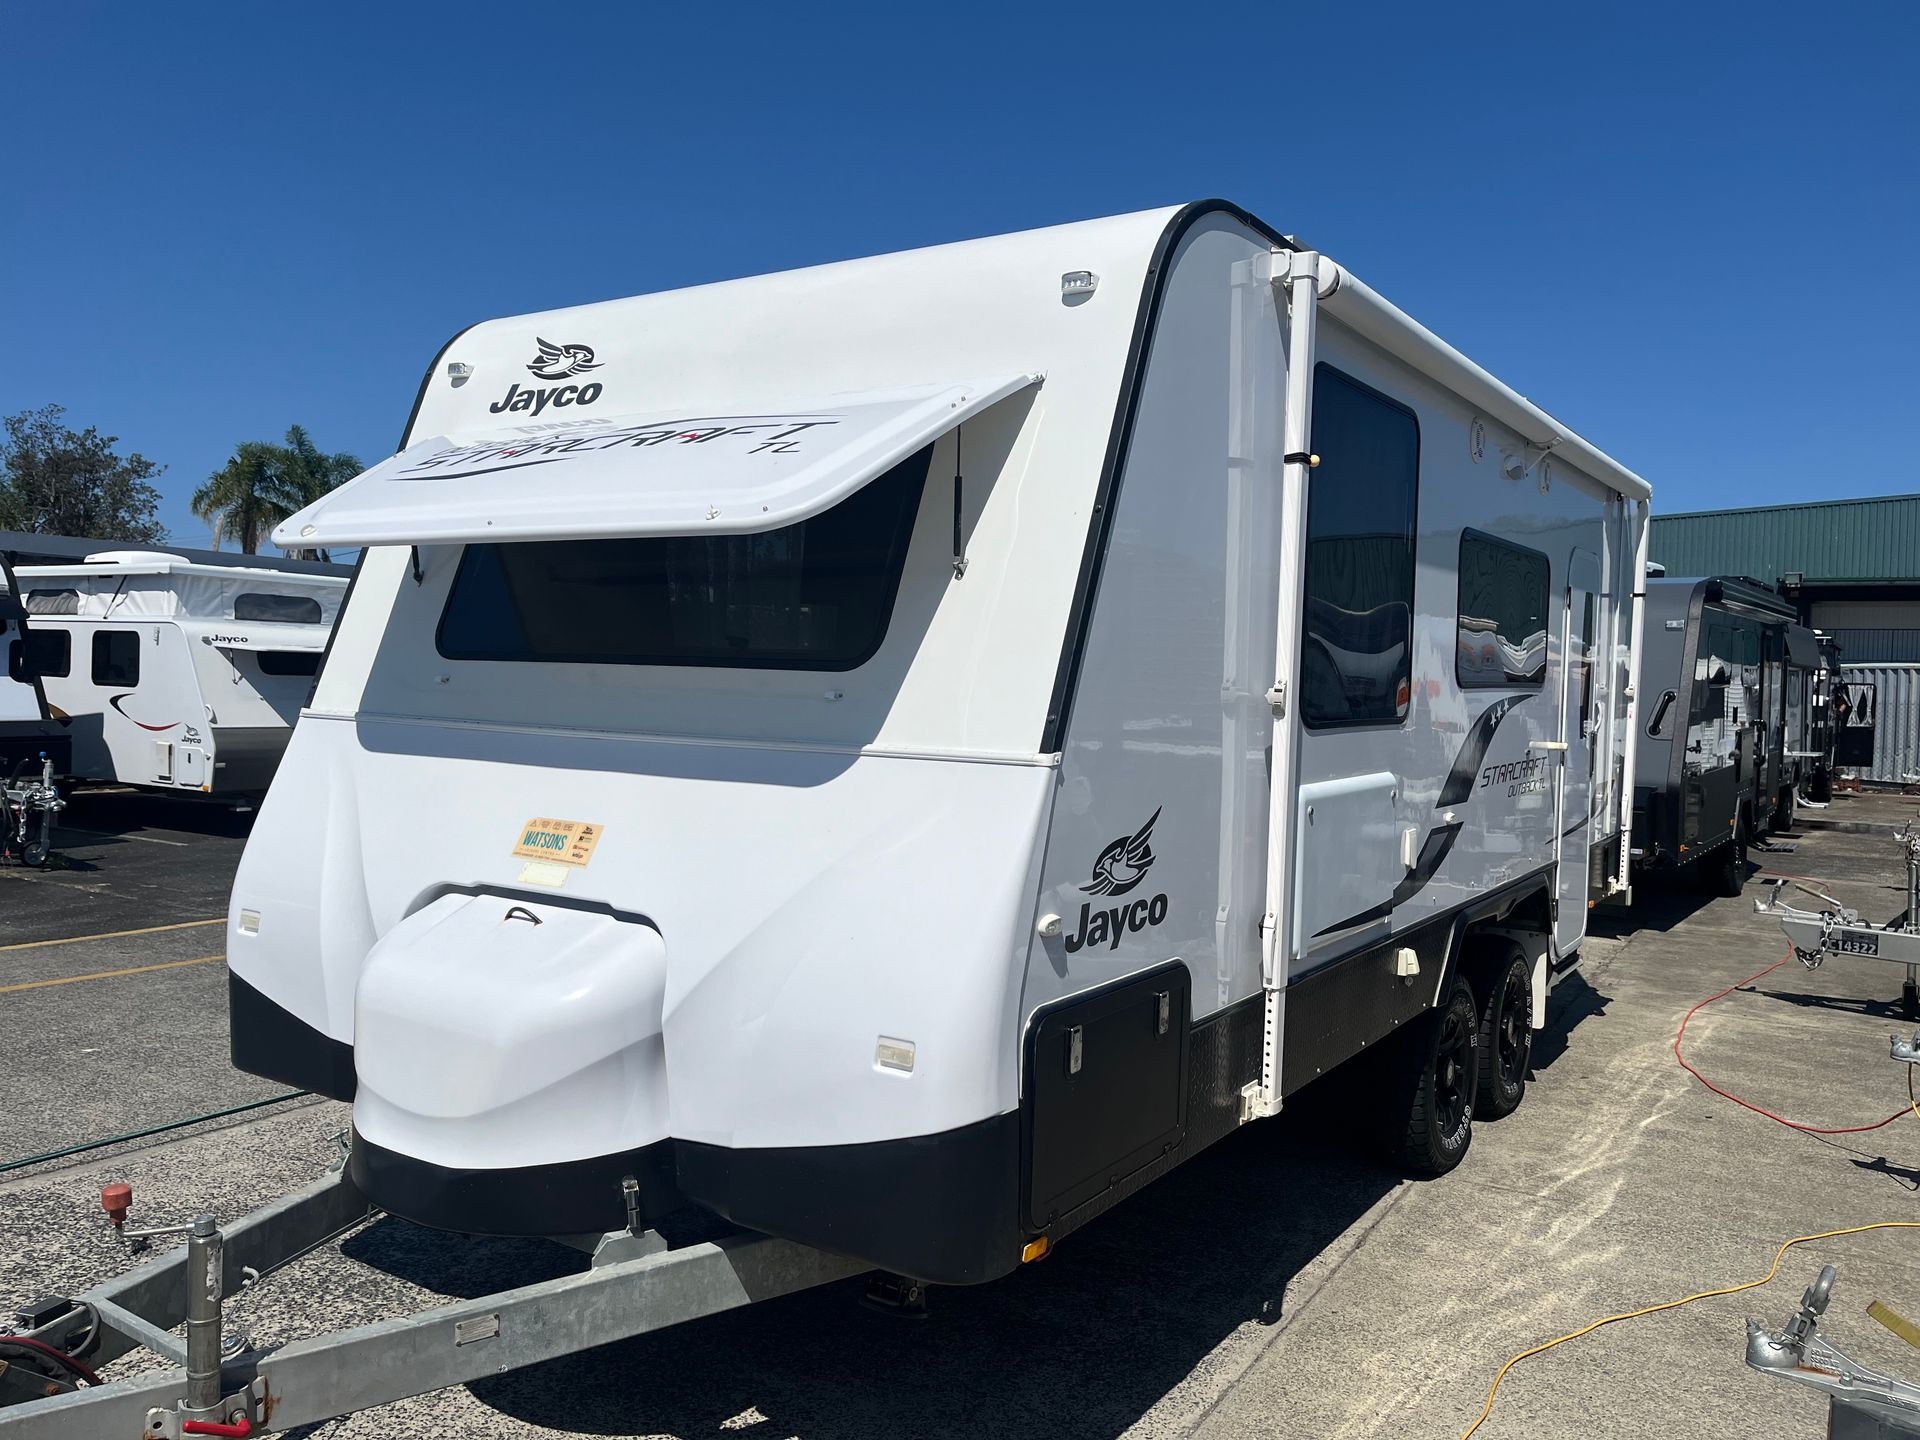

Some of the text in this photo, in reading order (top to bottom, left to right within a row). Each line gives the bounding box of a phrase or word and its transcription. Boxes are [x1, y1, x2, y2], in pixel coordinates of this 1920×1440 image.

[489, 381, 603, 417] Jayco
[398, 420, 841, 474] STARCRAFT
[210, 634, 249, 644] Jayco
[181, 735, 202, 745] Jayco
[1480, 756, 1548, 788] STARCRAFT
[1507, 780, 1537, 798] OUTBACK
[522, 830, 568, 851] WATSONS
[1065, 893, 1169, 954] Jayco
